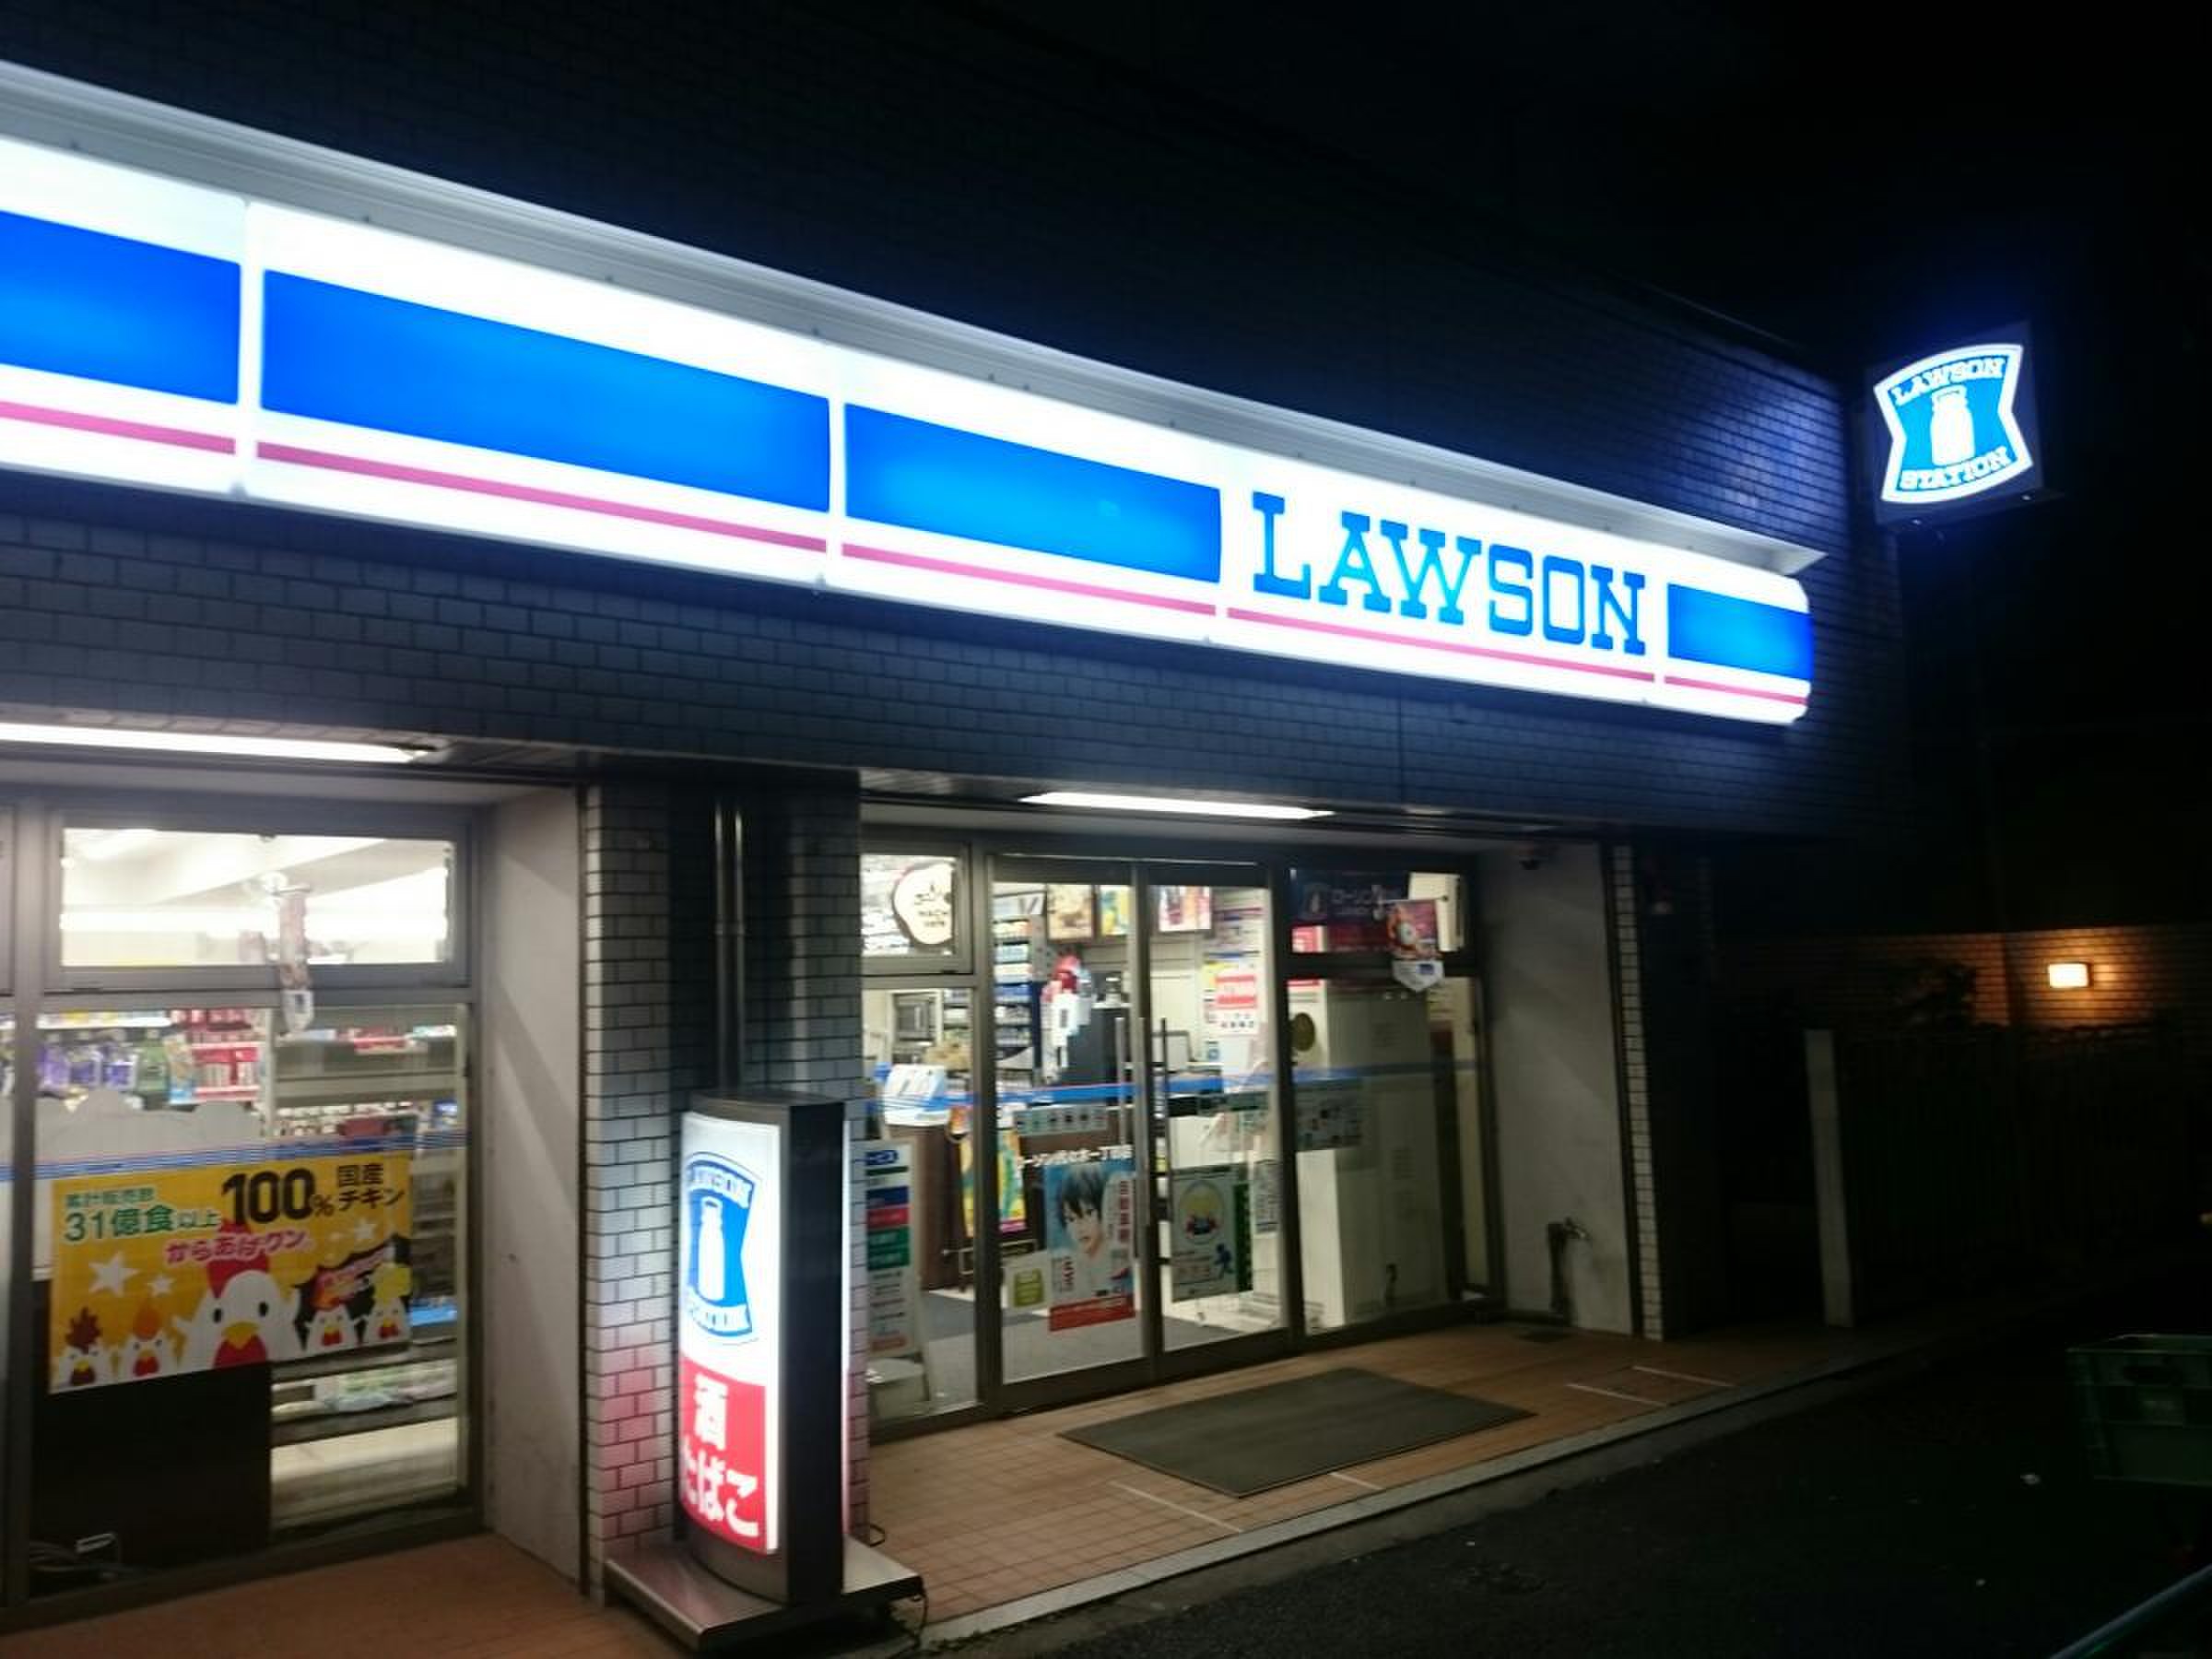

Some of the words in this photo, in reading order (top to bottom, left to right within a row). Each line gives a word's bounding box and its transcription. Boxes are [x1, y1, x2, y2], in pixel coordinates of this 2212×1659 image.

[1890, 357, 2006, 406] LAWSON
[1898, 445, 2012, 490] STATION
[1253, 491, 1646, 655] LAWSON
[337, 1187, 405, 1212] チキン
